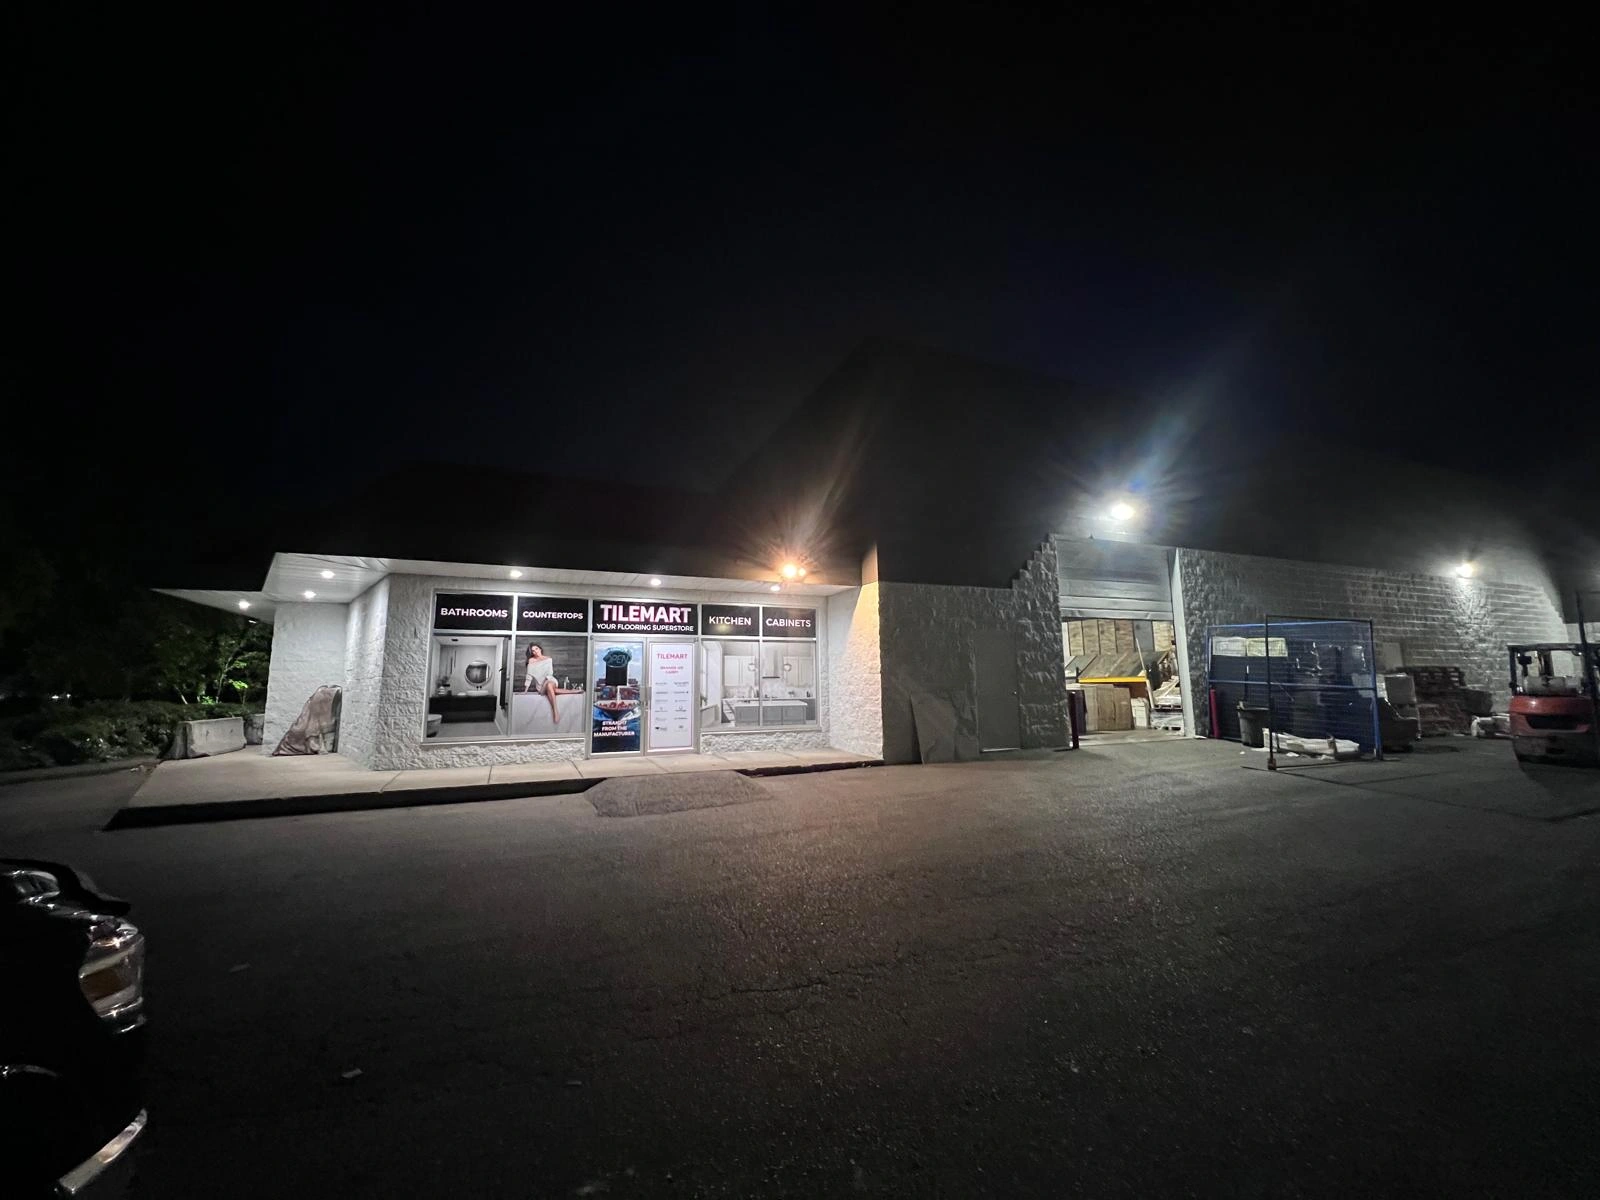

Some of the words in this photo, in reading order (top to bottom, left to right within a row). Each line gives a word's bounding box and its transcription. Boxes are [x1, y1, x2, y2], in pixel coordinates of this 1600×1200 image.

[440, 607, 508, 619] BATHROOMS
[522, 610, 584, 620] COUNTERTOPS
[600, 604, 692, 624] TILEMART
[709, 615, 752, 626] KITCHEN
[765, 617, 812, 628] CABINETS
[596, 623, 617, 631] YOUR
[652, 624, 694, 632] SUPERSTORE
